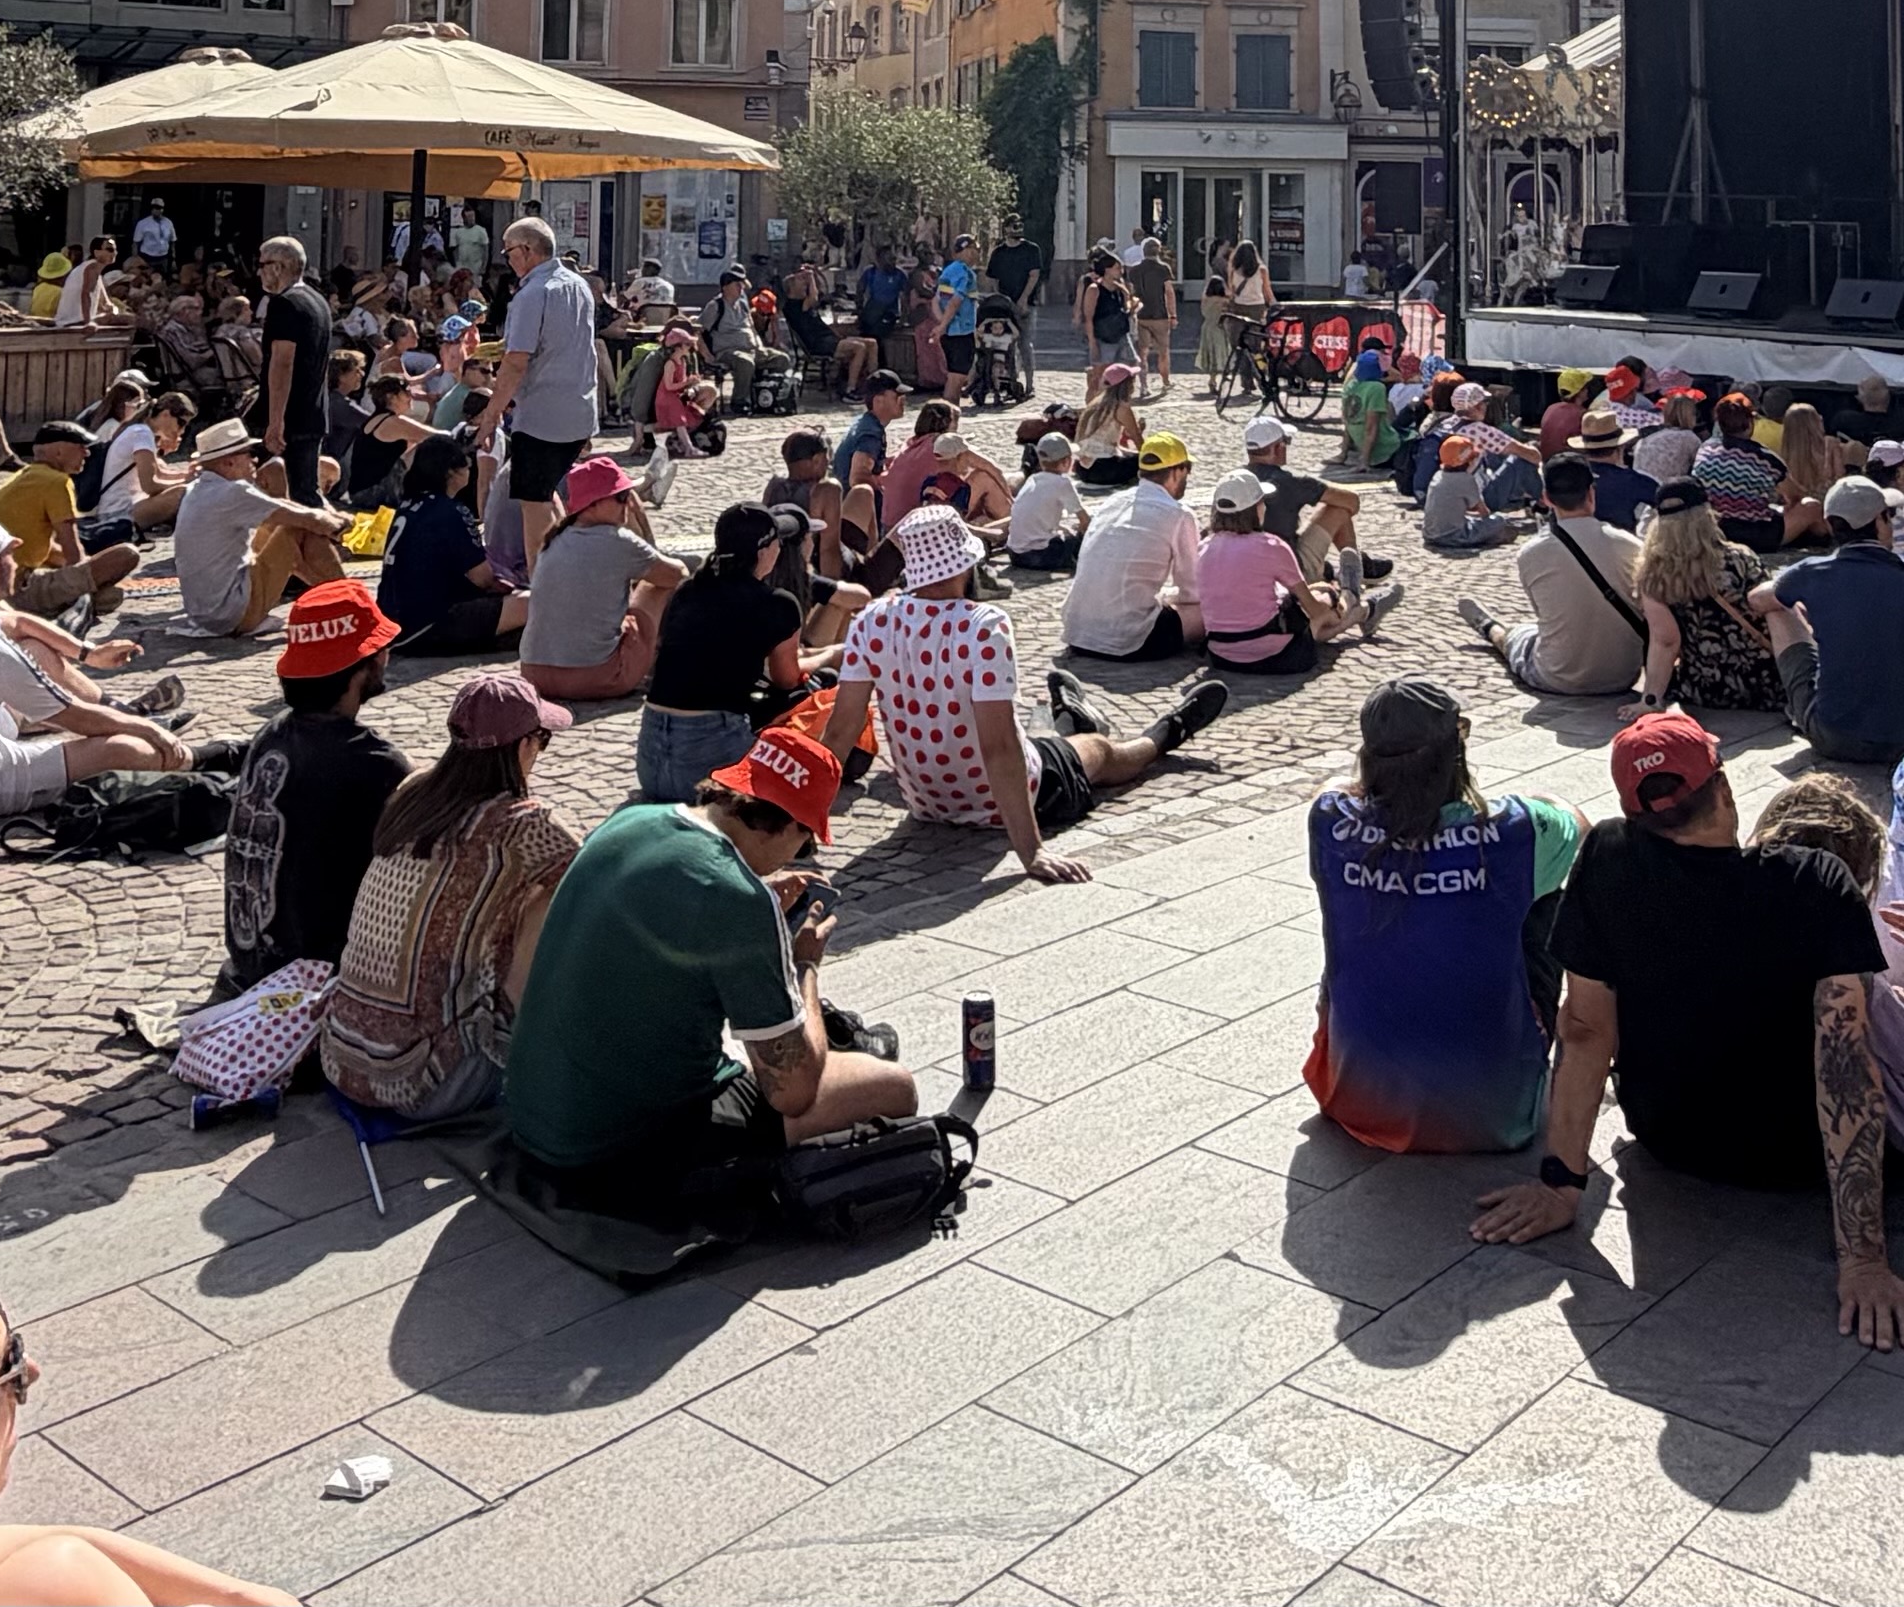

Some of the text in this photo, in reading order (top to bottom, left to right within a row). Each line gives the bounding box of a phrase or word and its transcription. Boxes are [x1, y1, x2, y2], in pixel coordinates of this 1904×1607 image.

[1632, 751, 1666, 773] TKO
[1343, 861, 1486, 895] CMA CGM
